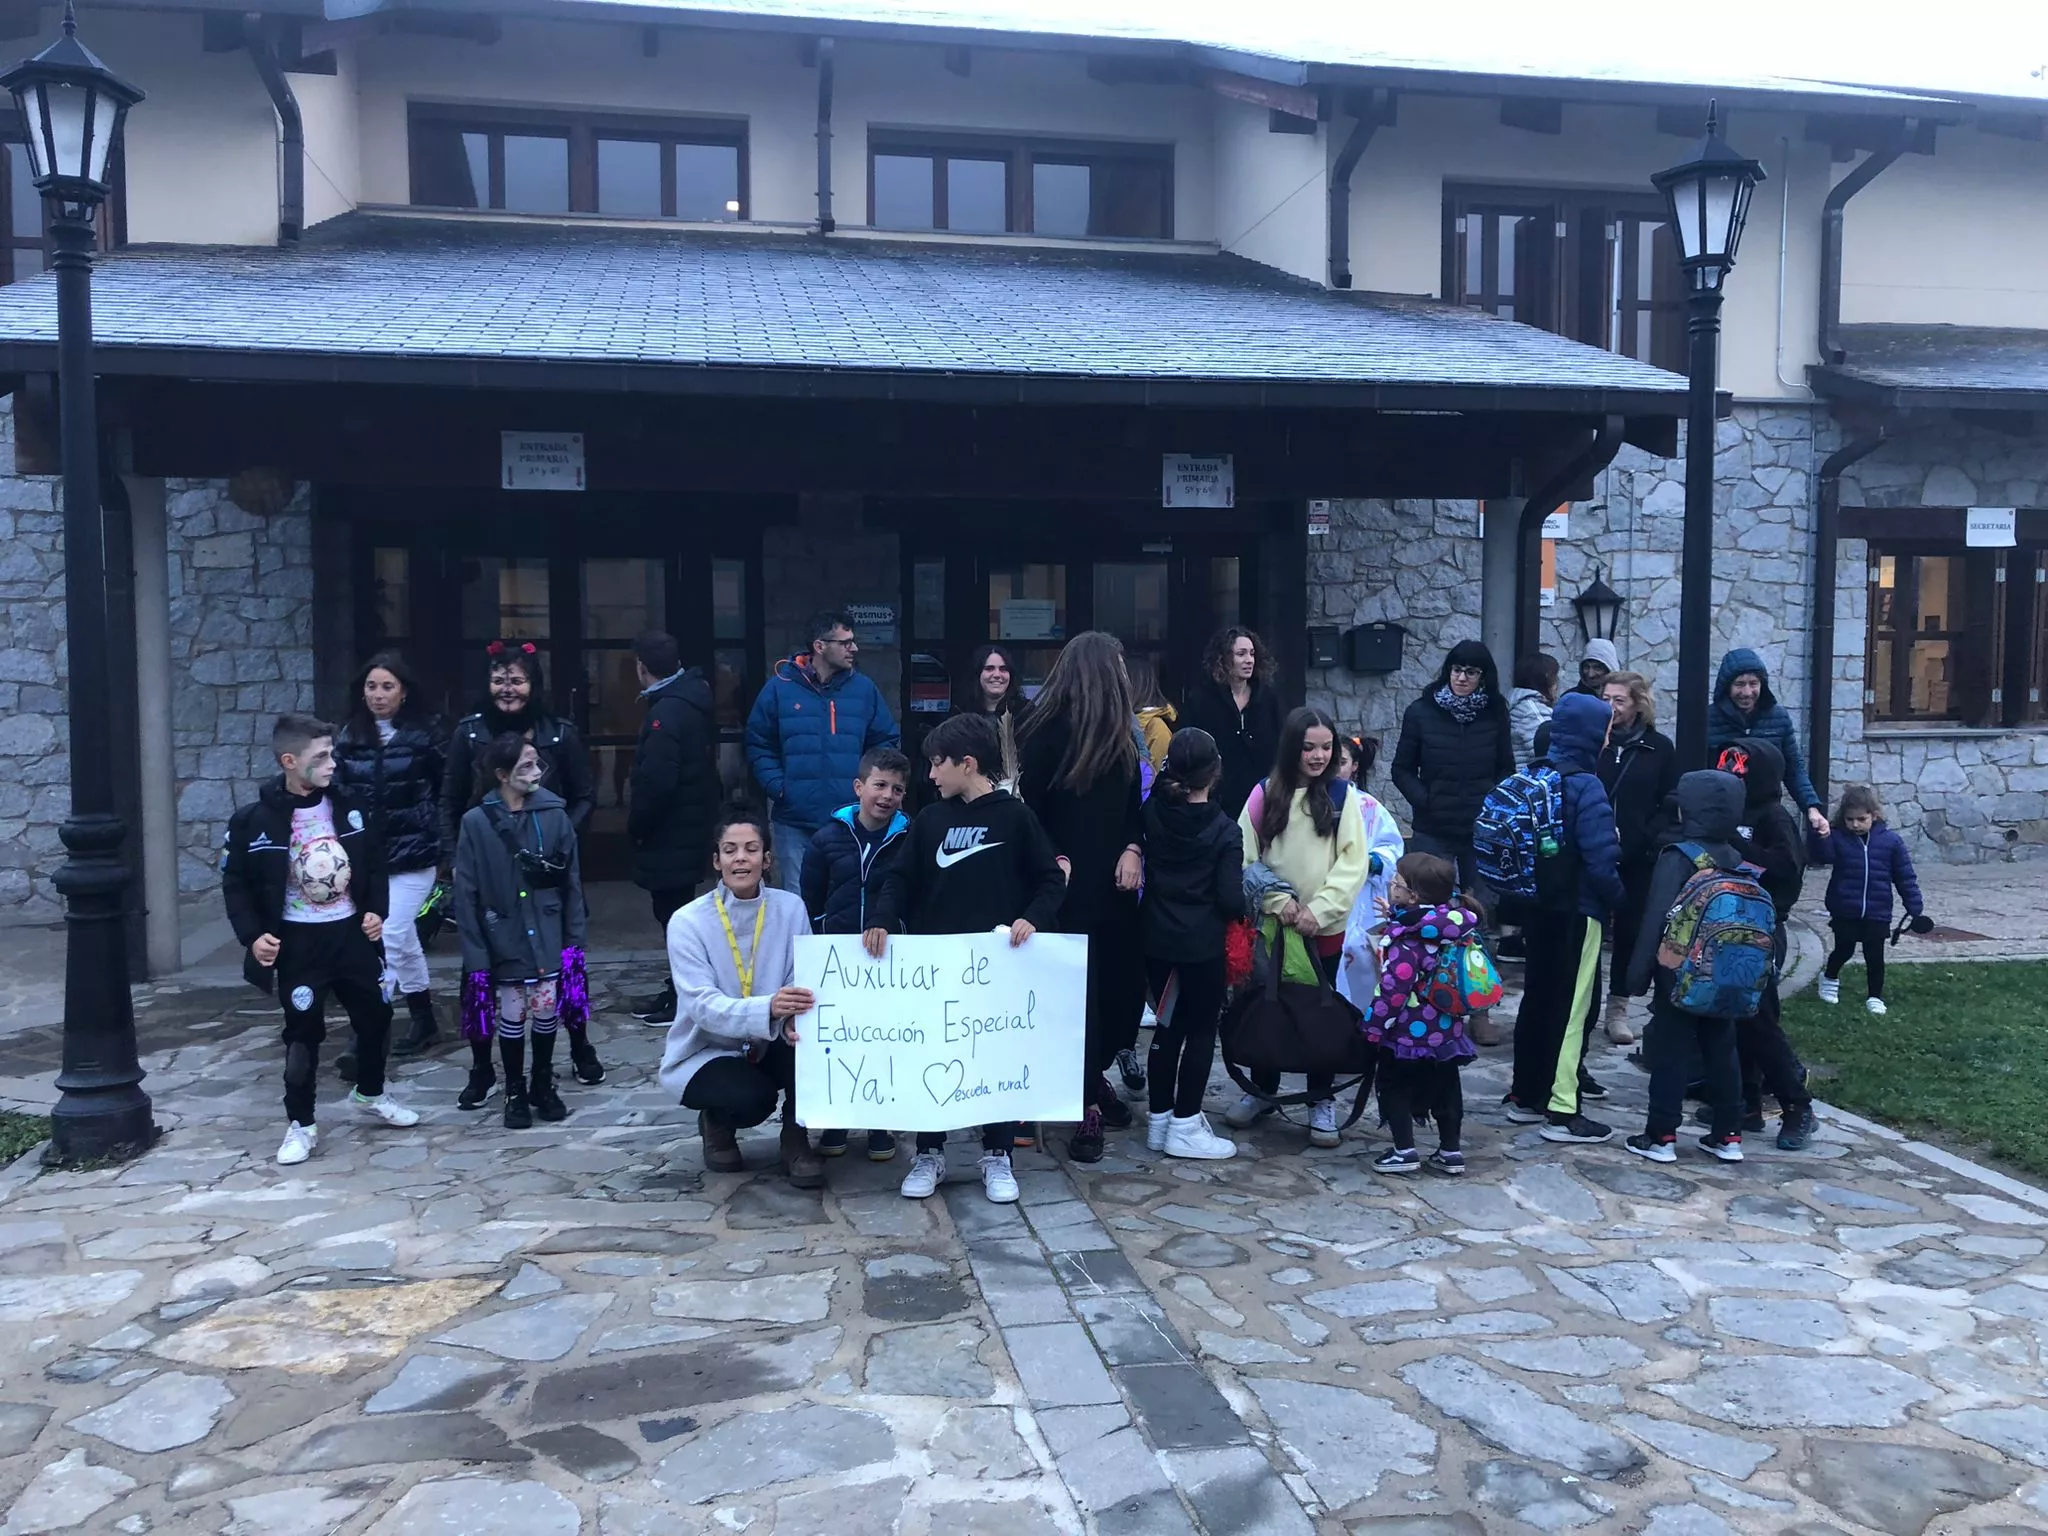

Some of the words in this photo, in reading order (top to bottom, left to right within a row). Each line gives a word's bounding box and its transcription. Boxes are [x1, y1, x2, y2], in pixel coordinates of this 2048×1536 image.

[519, 441, 569, 452] ENTRADA
[518, 454, 570, 464] PRIMARIA
[1177, 463, 1219, 472] ENTRADA
[1176, 474, 1220, 483] PRIMARIA
[848, 610, 892, 619] Erasmus+
[944, 826, 989, 849] NIKE
[820, 944, 940, 990] Auxiliar
[961, 948, 991, 986] de
[817, 1003, 925, 1044] Educación
[944, 989, 1036, 1059] Especial
[824, 1047, 896, 1105] ¡Ya!
[954, 1080, 992, 1102] escuela
[998, 1064, 1030, 1091] rural
